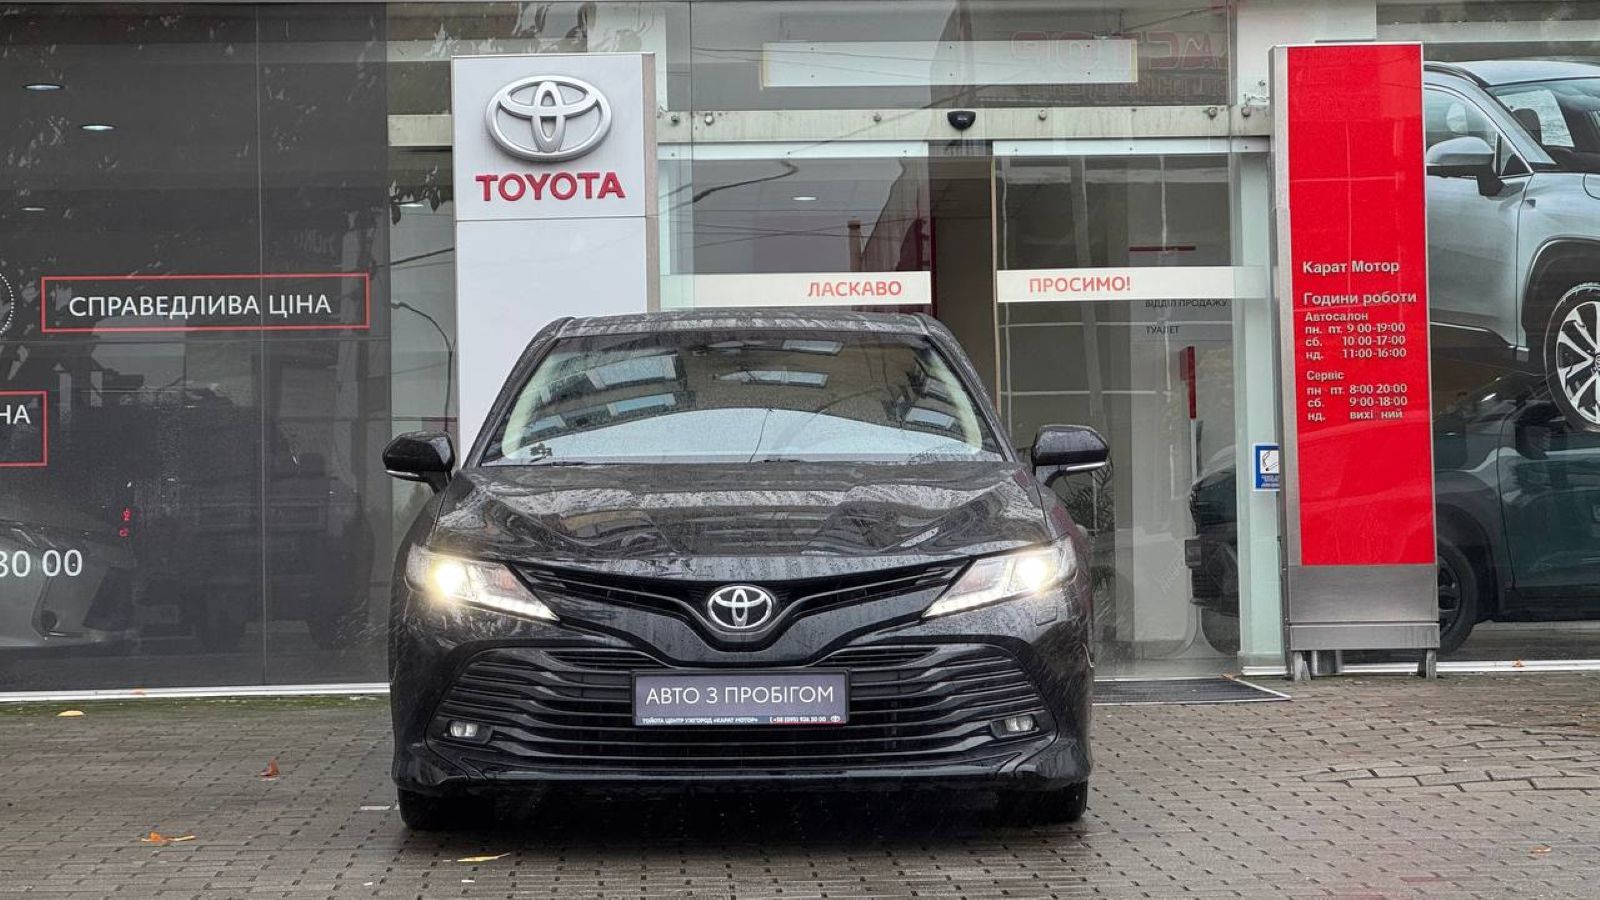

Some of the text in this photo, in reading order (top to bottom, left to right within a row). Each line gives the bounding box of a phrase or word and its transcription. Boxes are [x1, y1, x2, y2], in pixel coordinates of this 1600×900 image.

[475, 171, 625, 202] TOYOTA
[1302, 259, 1400, 276] Карат Мотор
[807, 276, 1131, 298] ЛАСКАВО ПРОСИМО!
[1179, 298, 1227, 307] ПРОДАЖУ
[1303, 291, 1417, 307] Години роботи
[68, 292, 332, 322] СПРАВЕДЛИВА ЦІНА
[1304, 311, 1369, 322] Автосалон
[1146, 325, 1179, 335] ТУАЛЕТ
[1305, 336, 1406, 347] сб. 1000-17:00
[1305, 348, 1407, 361] нд. 11:00-16:00
[1306, 370, 1345, 382] Сервіс
[1307, 398, 1325, 408] сб.
[1308, 412, 1326, 422] нд.
[42, 549, 83, 577] 00
[646, 687, 700, 705] АВТО
[725, 686, 834, 704] ПРОБІГОМ
